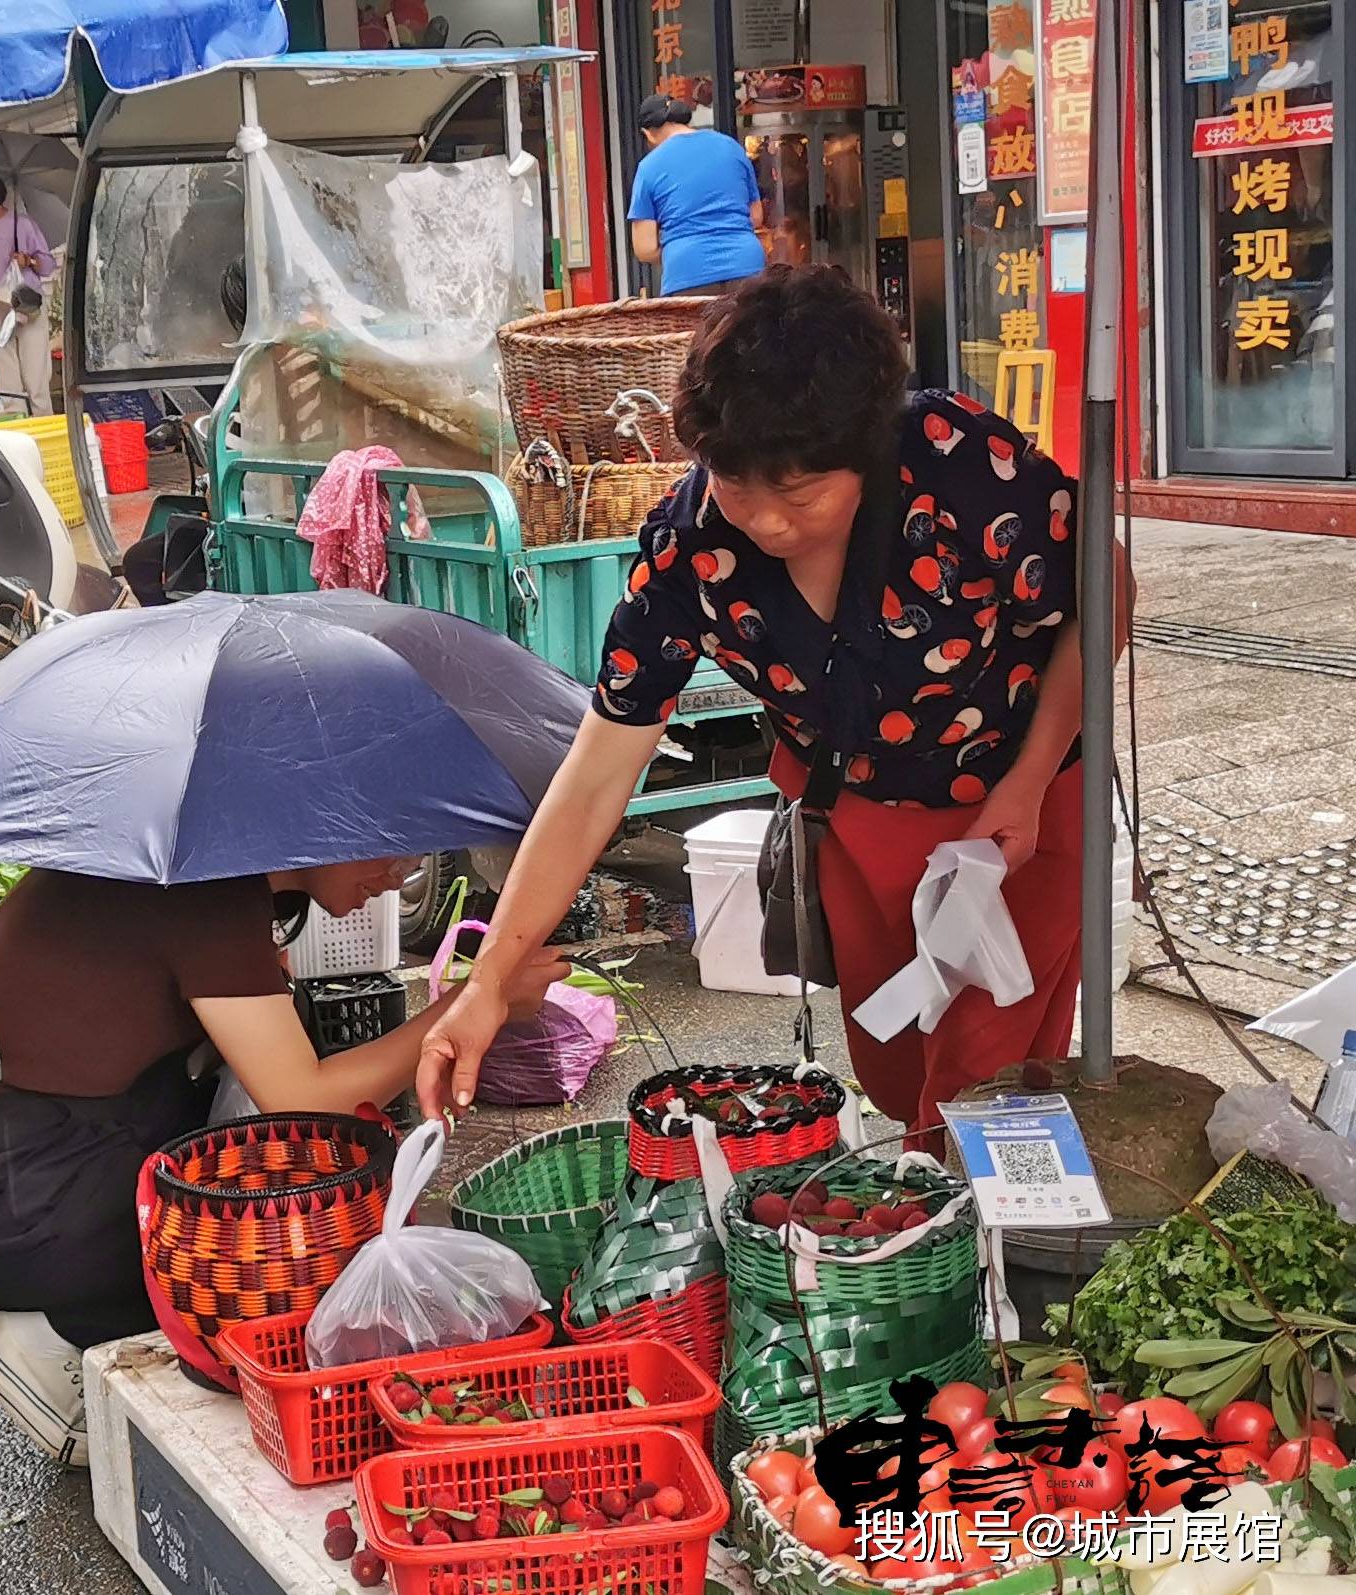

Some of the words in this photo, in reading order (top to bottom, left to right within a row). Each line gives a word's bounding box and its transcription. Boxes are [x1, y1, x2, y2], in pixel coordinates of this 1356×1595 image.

[1229, 0, 1292, 349] 鸭现烤现卖
